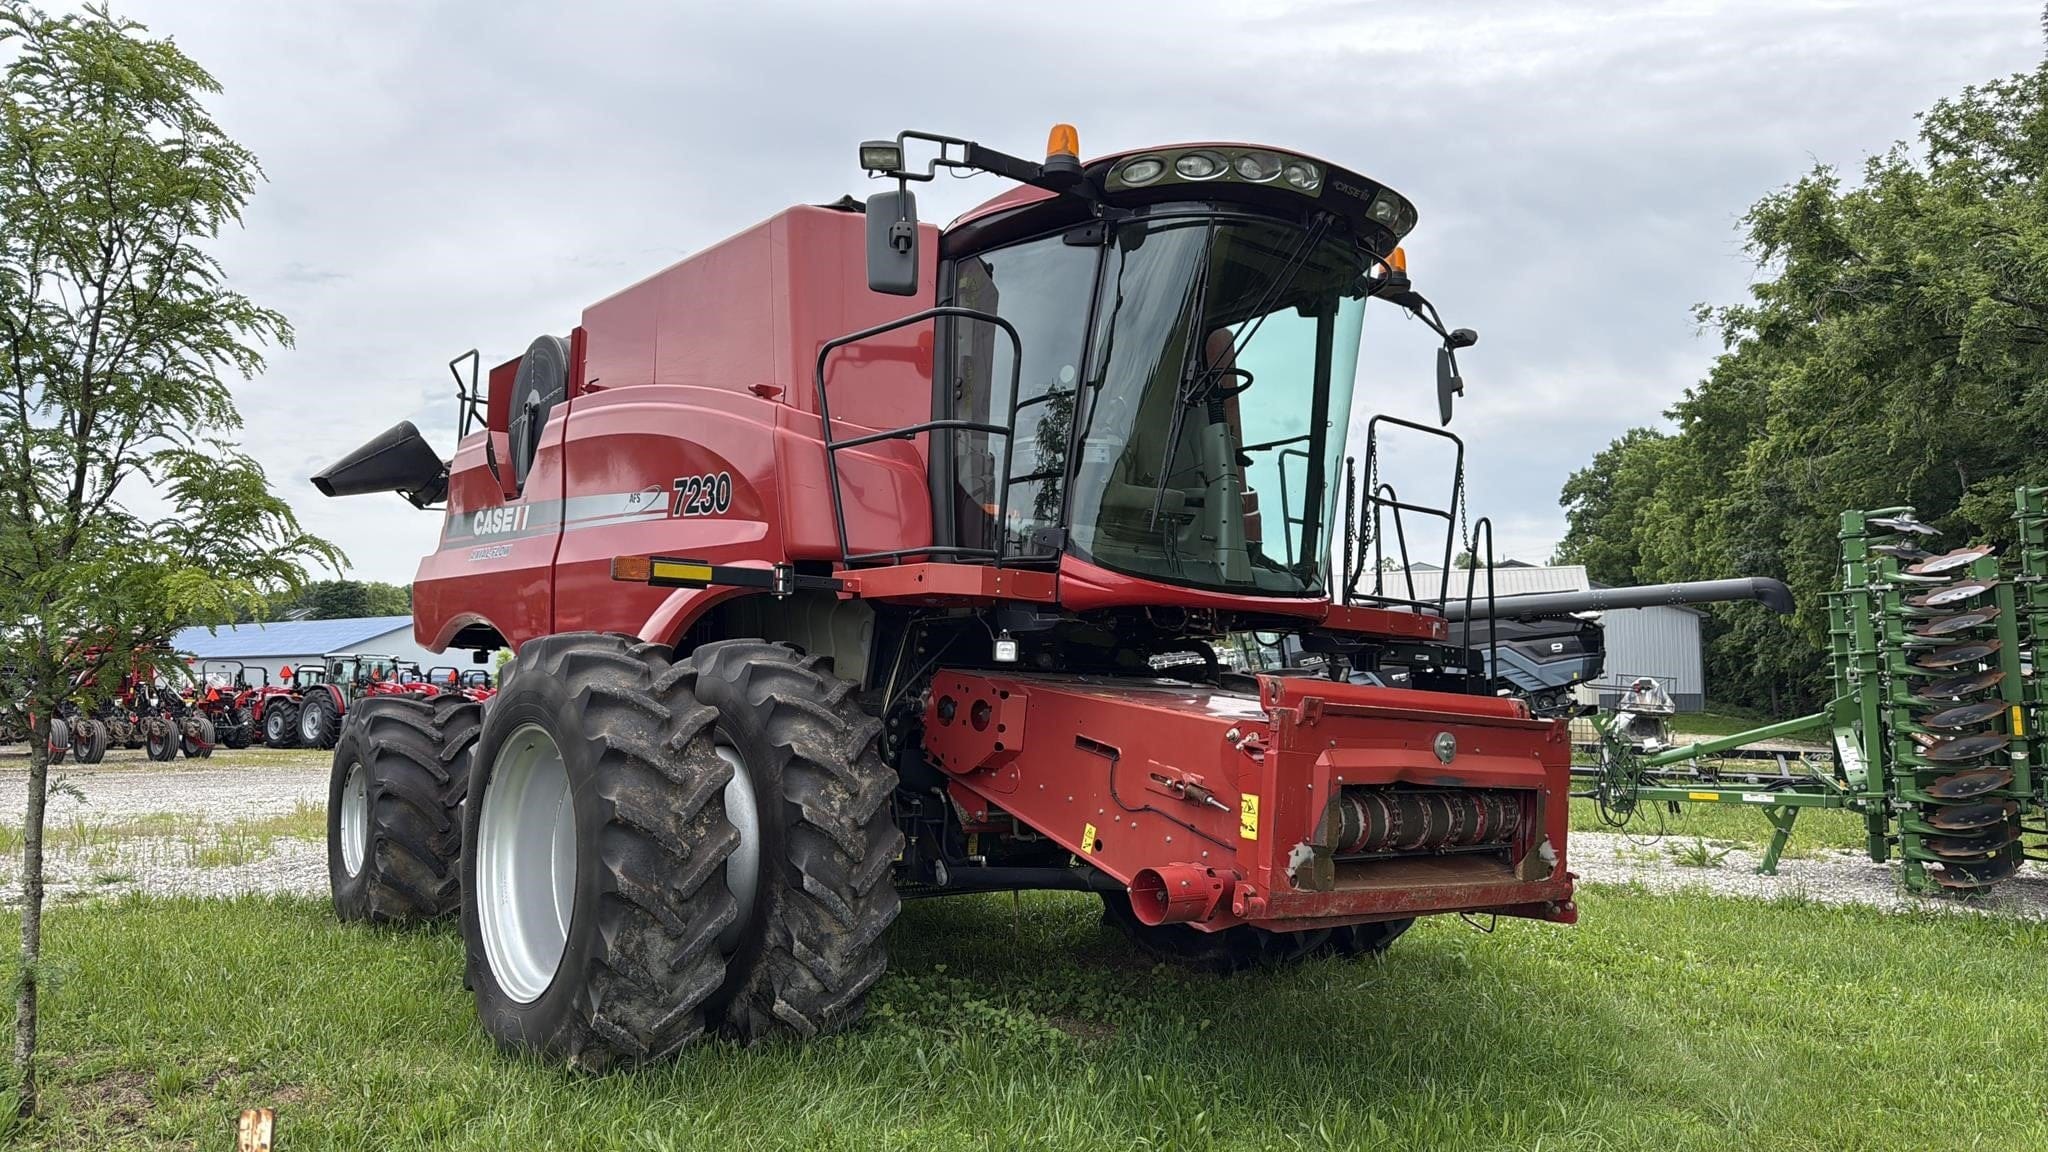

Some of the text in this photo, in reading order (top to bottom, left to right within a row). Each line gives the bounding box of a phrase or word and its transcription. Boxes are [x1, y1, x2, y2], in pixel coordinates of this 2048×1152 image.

[629, 493, 641, 503] AFS
[671, 471, 732, 517] 7230
[473, 508, 515, 536] CASE
